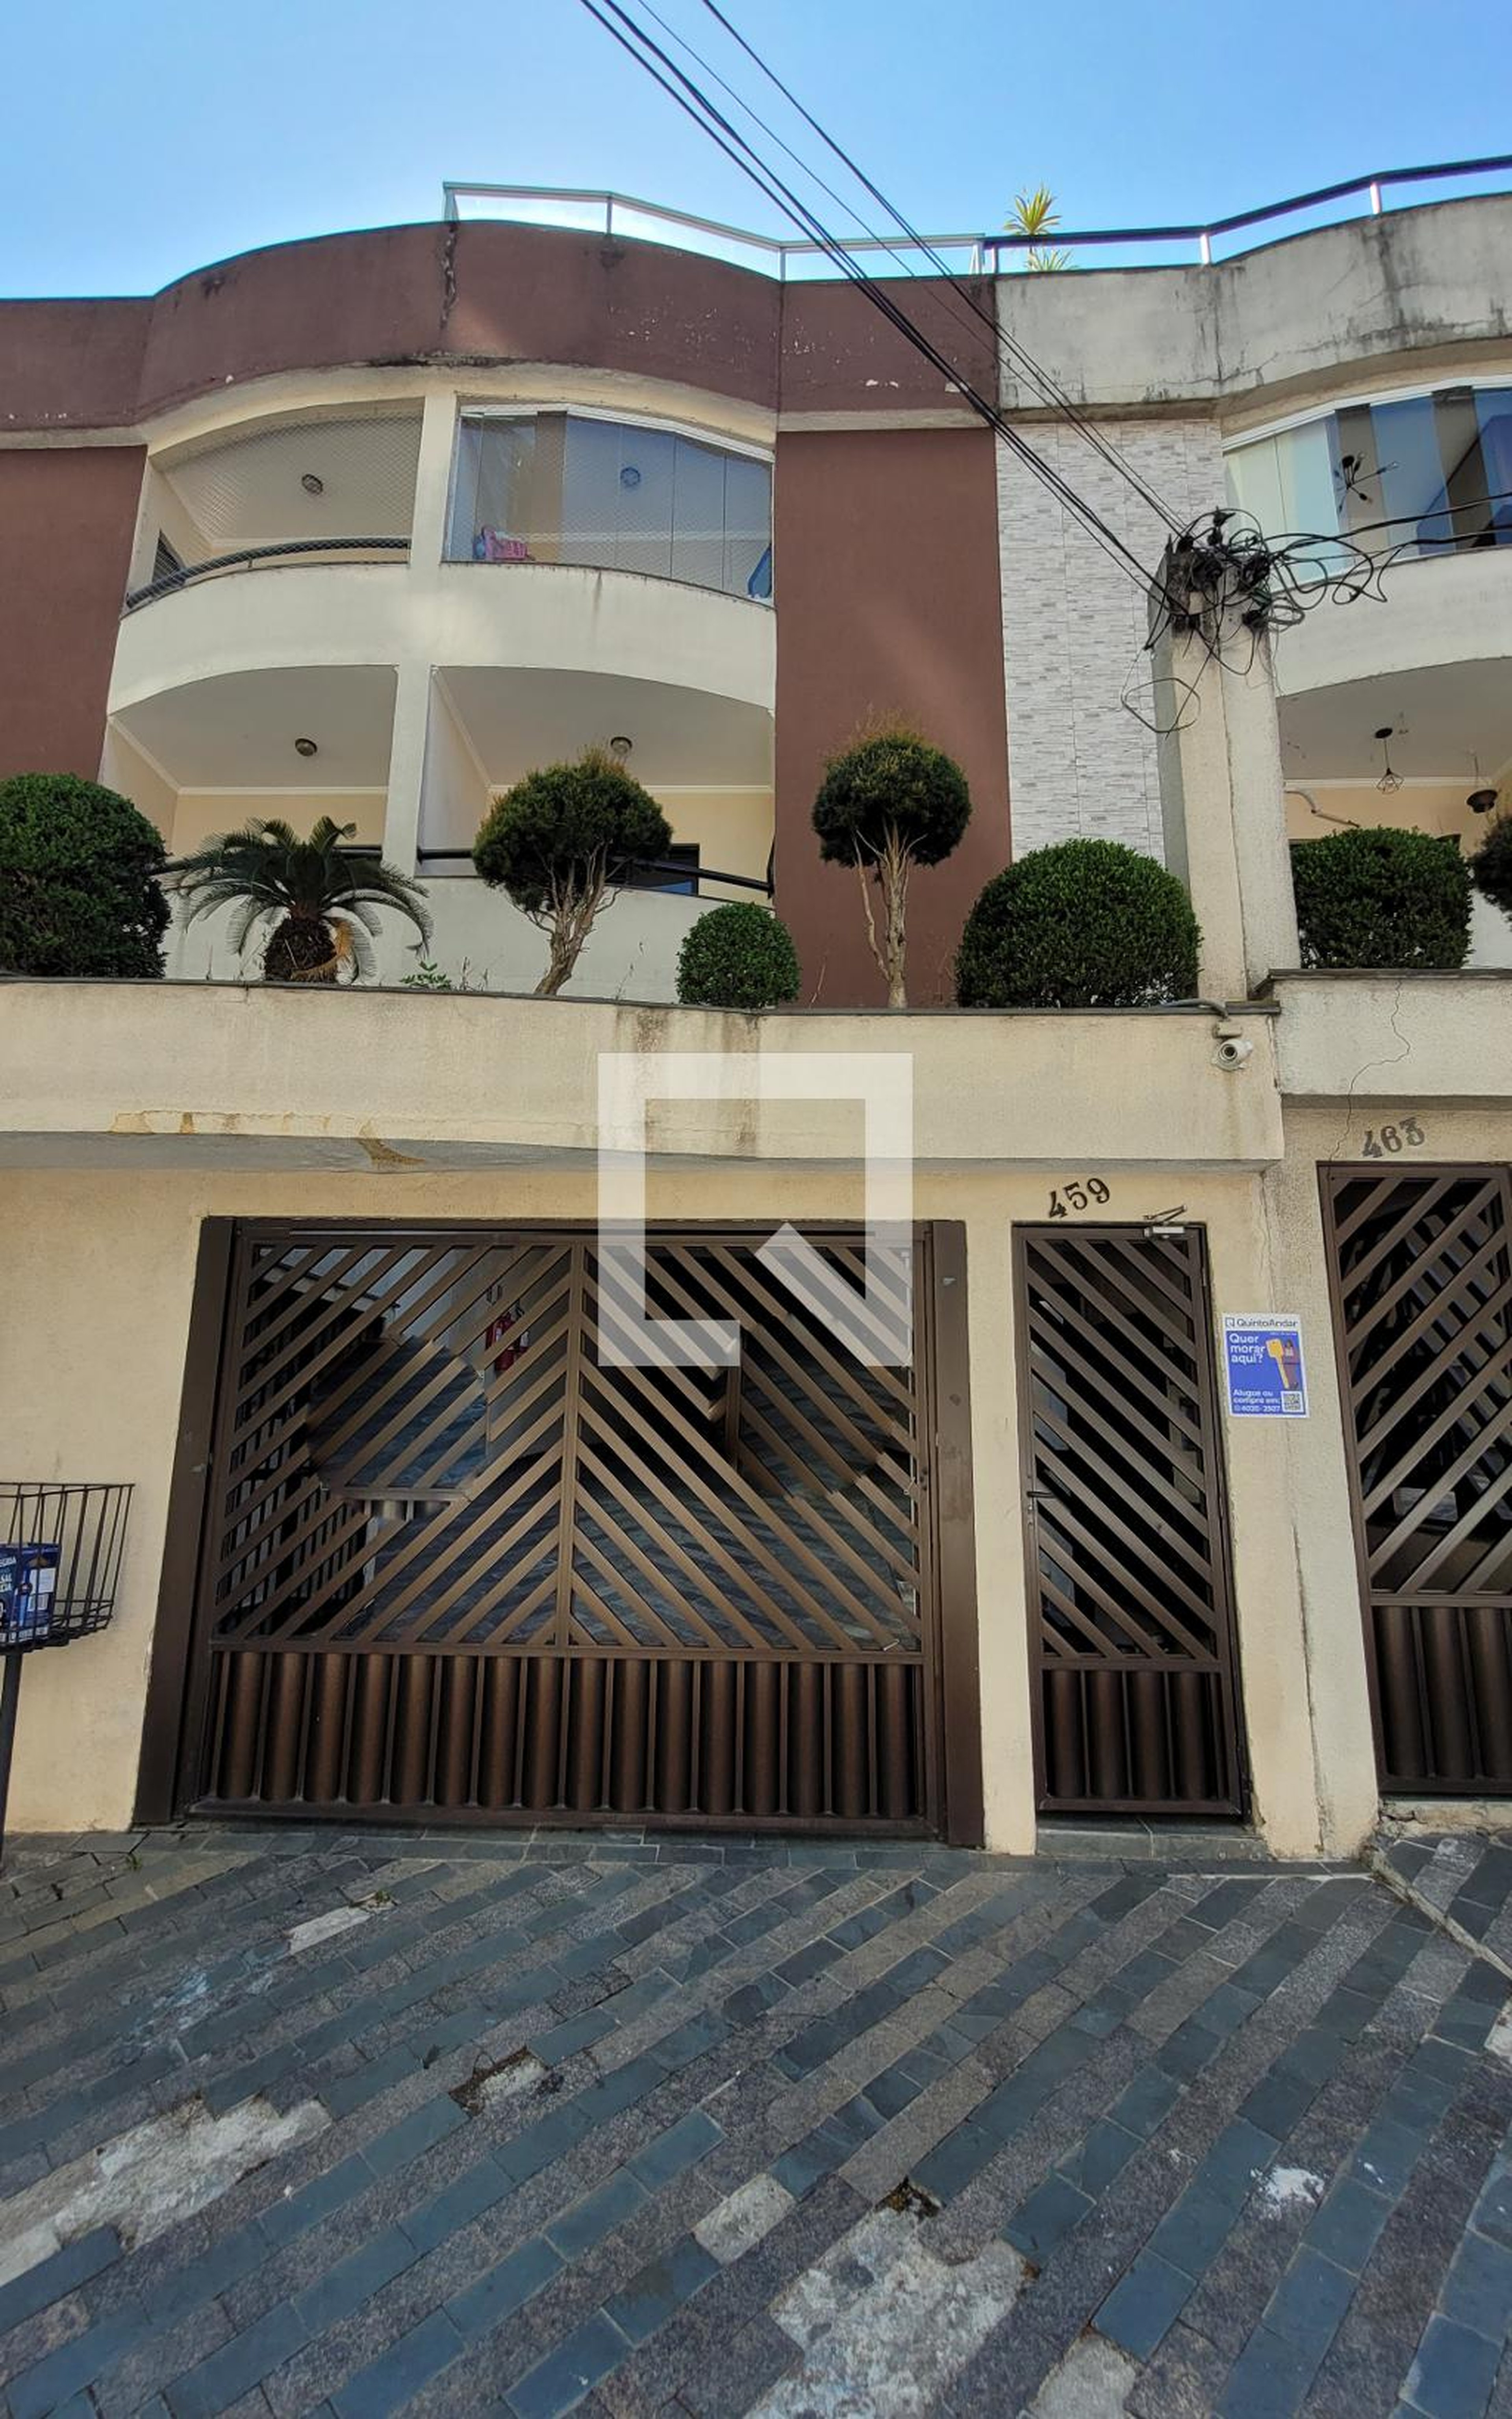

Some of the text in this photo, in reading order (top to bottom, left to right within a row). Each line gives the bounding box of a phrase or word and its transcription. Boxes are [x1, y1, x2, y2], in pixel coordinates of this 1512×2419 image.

[1362, 1117, 1425, 1158] 463
[1049, 1178, 1110, 1218] 459
[1237, 1318, 1298, 1327] QuintoAndar
[1229, 1333, 1259, 1344] Quer
[1230, 1345, 1266, 1353] morar
[1231, 1353, 1263, 1365] aqui?
